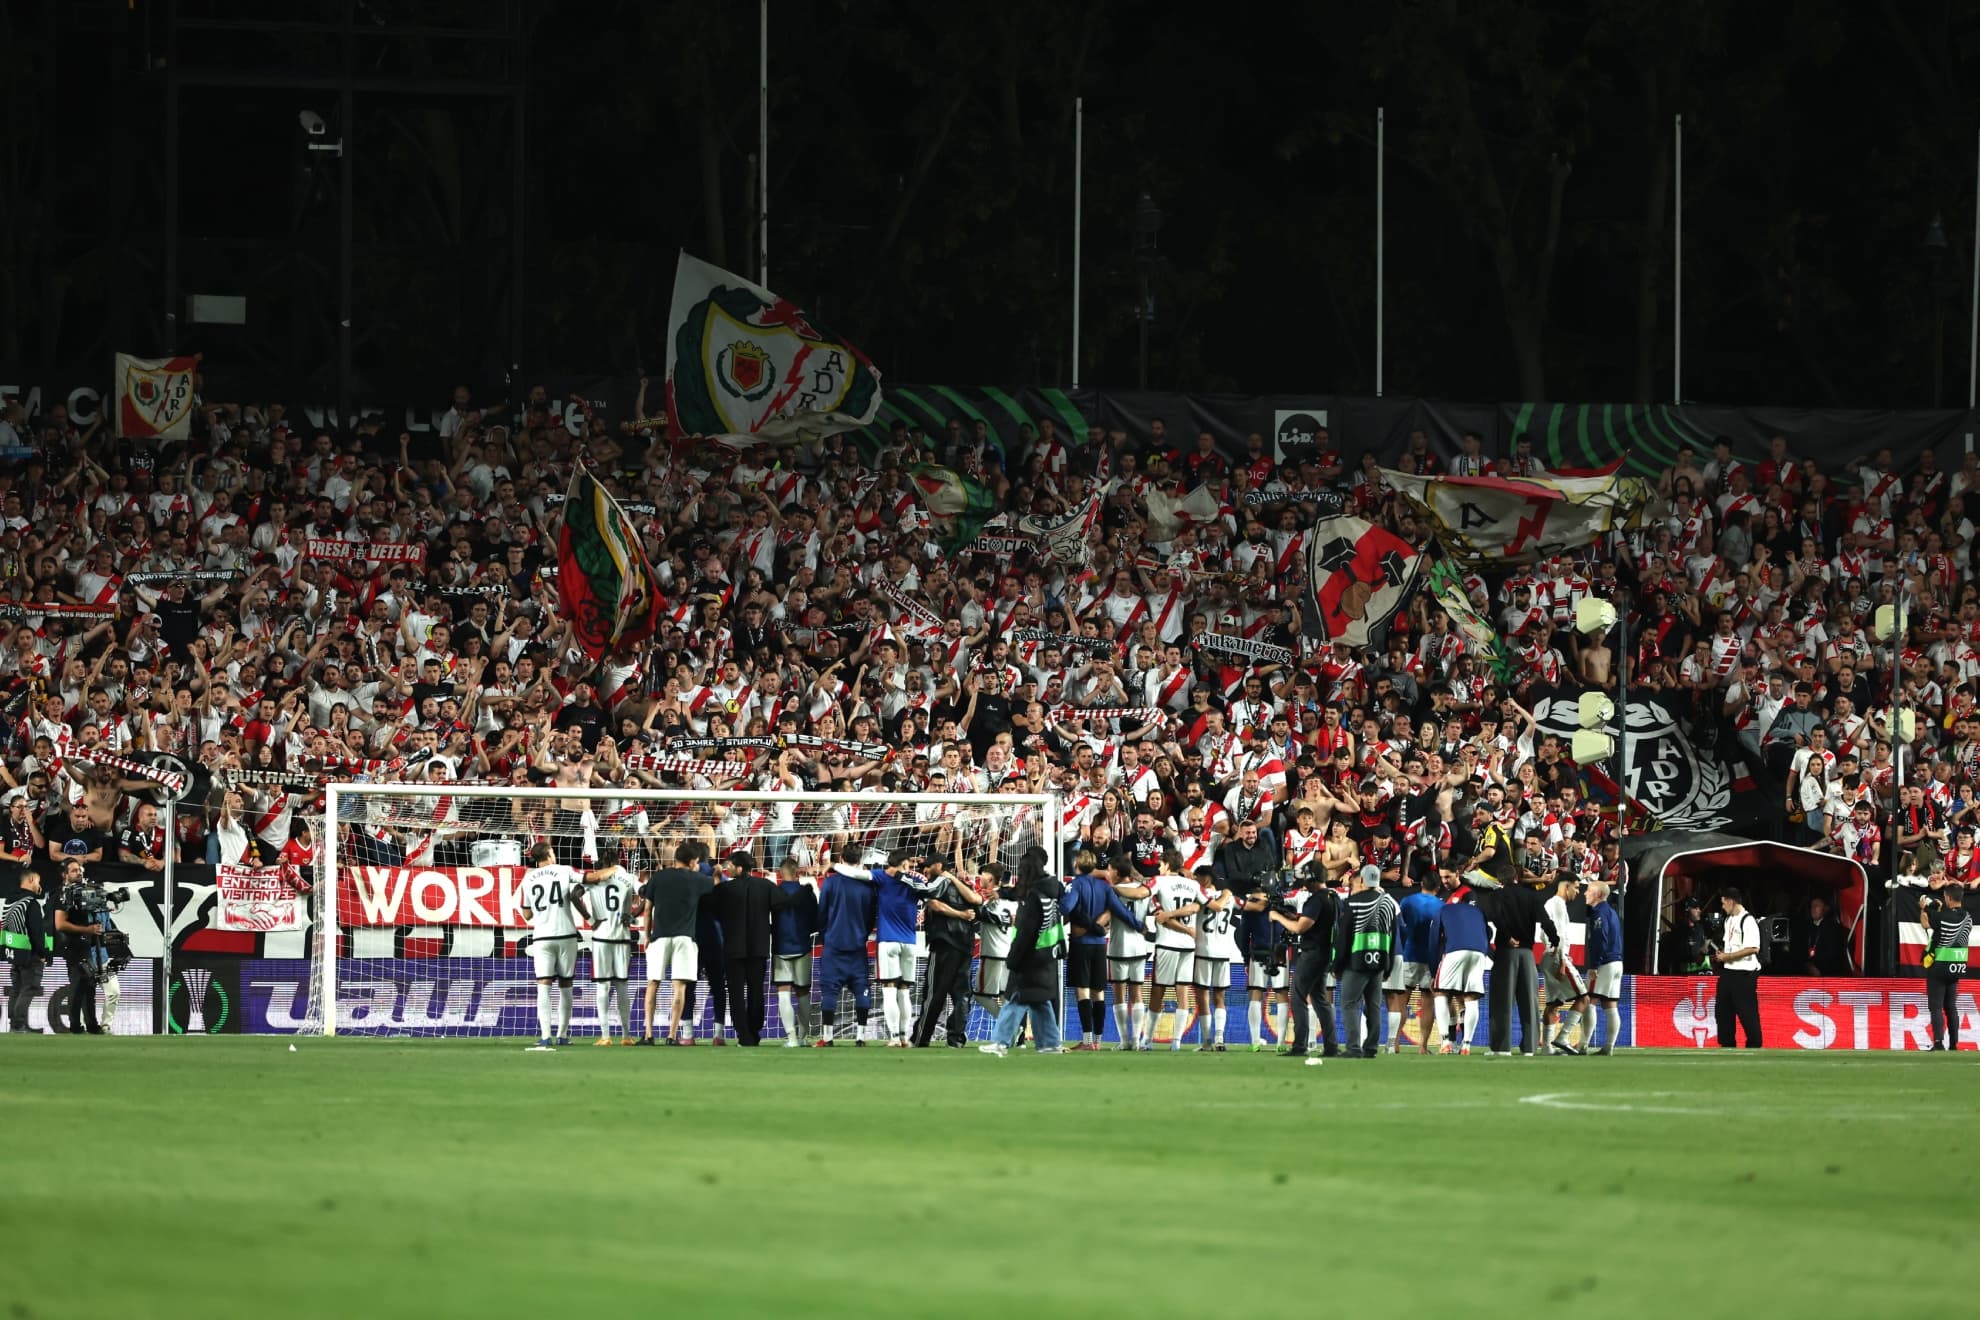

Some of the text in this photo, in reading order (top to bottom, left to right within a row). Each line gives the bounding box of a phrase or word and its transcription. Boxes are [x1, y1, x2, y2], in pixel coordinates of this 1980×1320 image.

[309, 541, 420, 560] PRESA VETE YA
[686, 738, 714, 746] JAHRE
[627, 755, 648, 770] EL
[222, 889, 296, 901] VISITANTES
[532, 881, 563, 912] 24
[605, 885, 619, 911] 6
[1202, 906, 1230, 934] 23
[1953, 950, 1967, 959] TV
